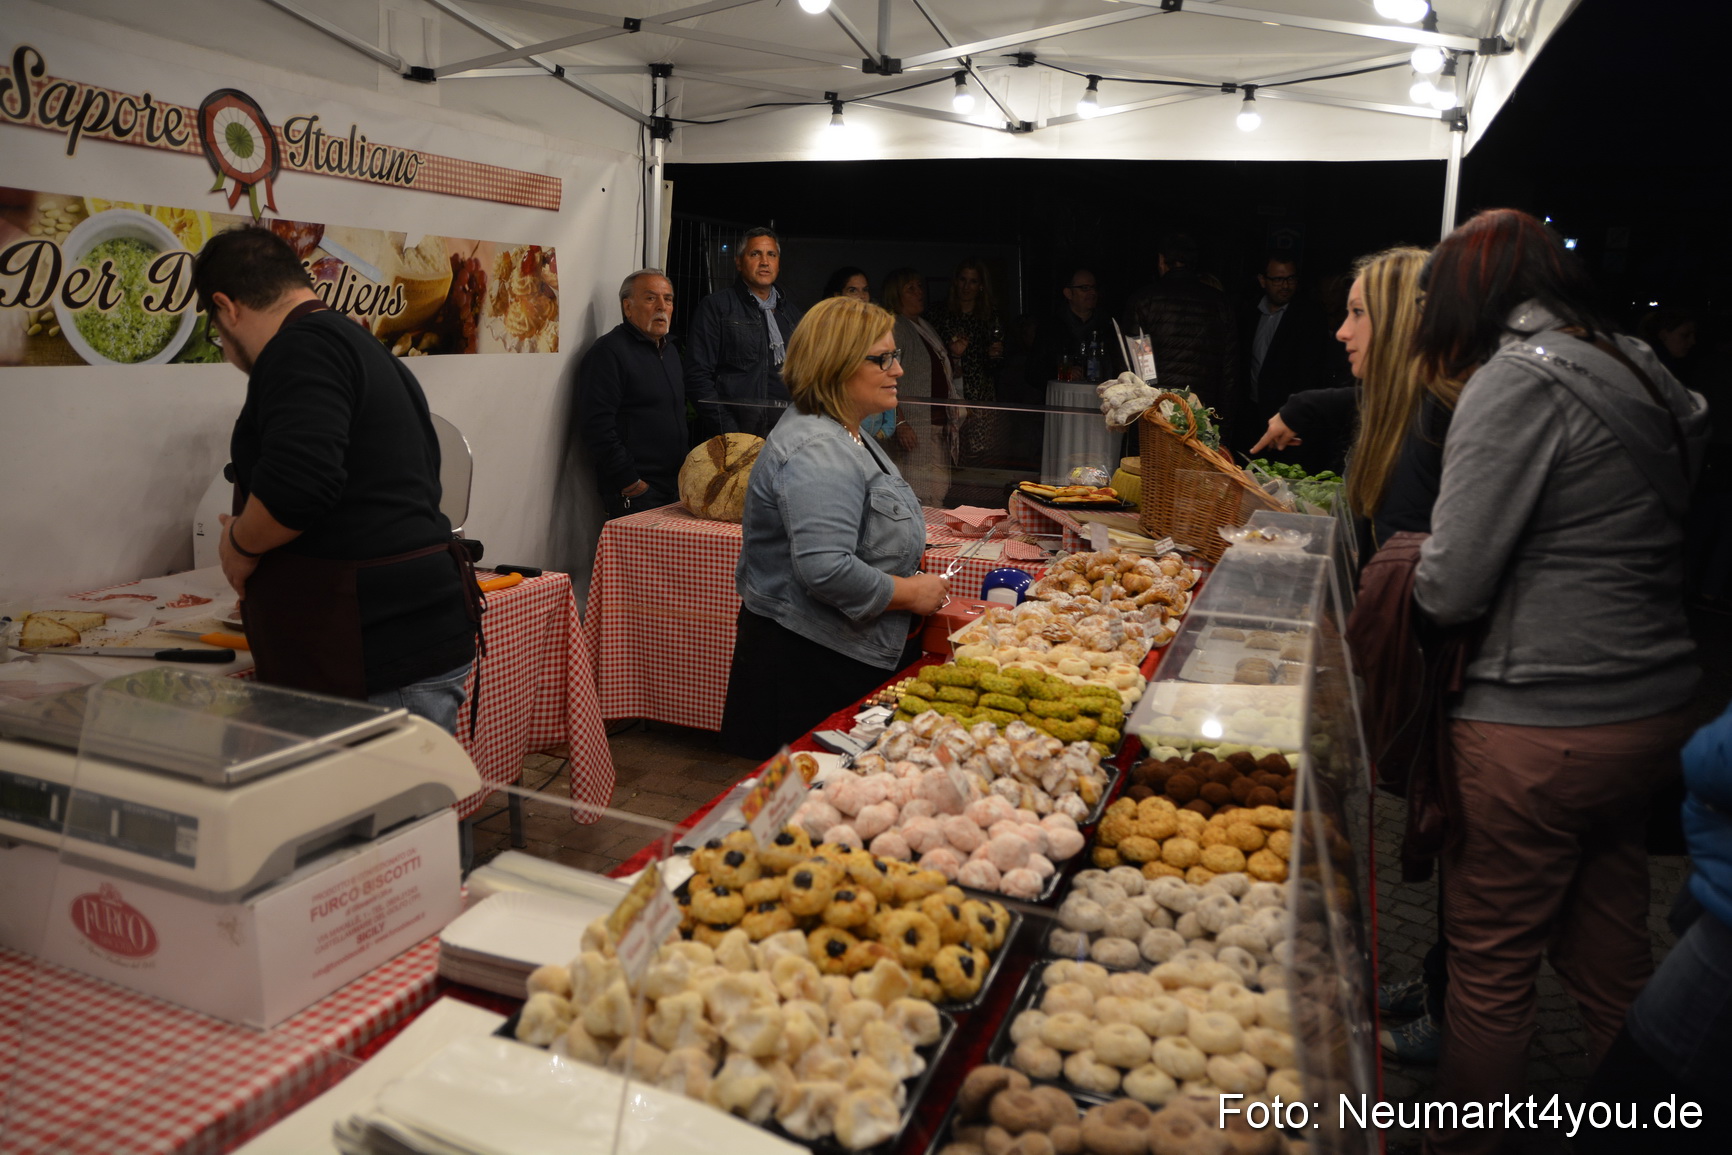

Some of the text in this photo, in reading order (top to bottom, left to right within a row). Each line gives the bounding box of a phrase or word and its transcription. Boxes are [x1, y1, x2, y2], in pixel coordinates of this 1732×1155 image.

[0, 44, 425, 187] Sapore Italiano
[0, 240, 121, 311] Der
[143, 251, 203, 315] D
[310, 887, 359, 923] FURCO
[362, 856, 422, 895] BISCOTTI
[82, 898, 149, 951] FURCO
[356, 921, 386, 945] SICILY
